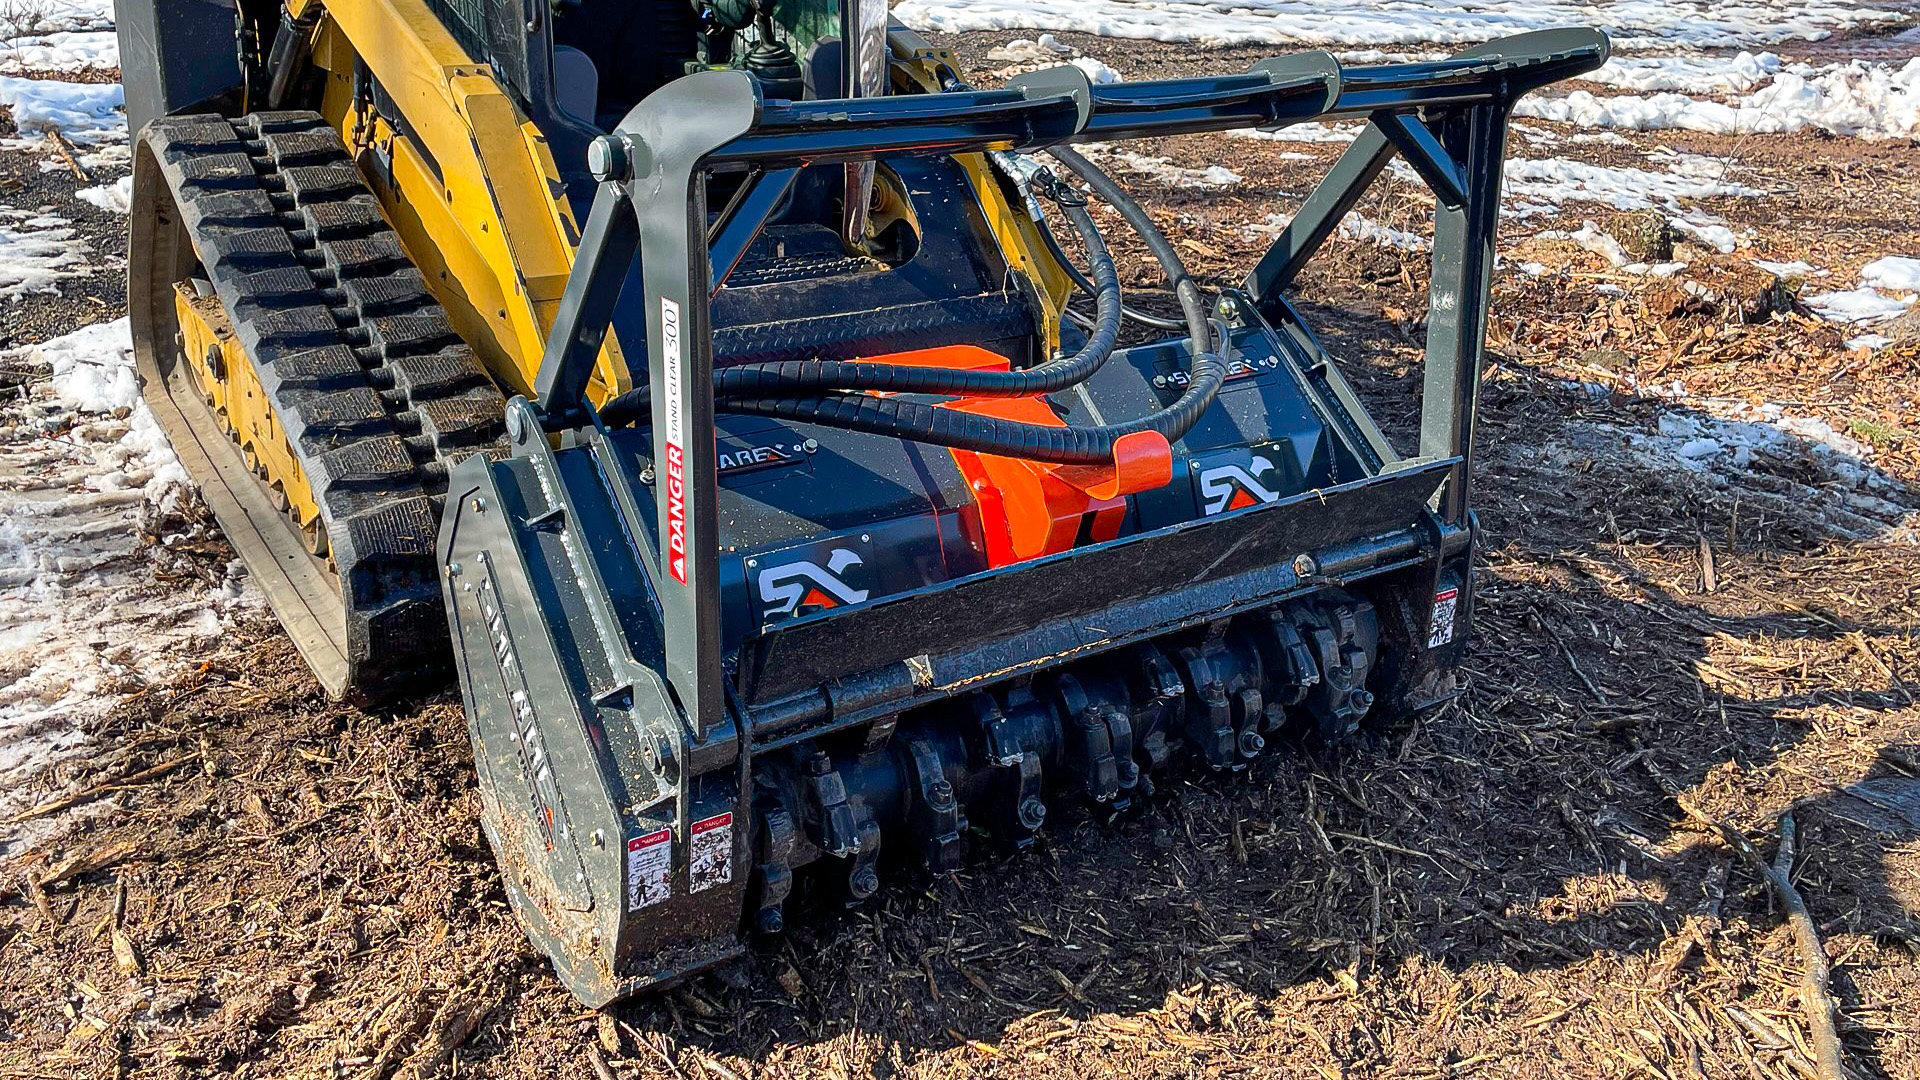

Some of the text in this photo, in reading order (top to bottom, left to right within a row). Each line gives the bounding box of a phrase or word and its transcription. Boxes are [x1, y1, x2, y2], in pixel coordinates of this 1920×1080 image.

[664, 303, 684, 548] DANGER STAND CLEAR 300'
[719, 443, 792, 469] AREX
[641, 834, 665, 846] DANGER
